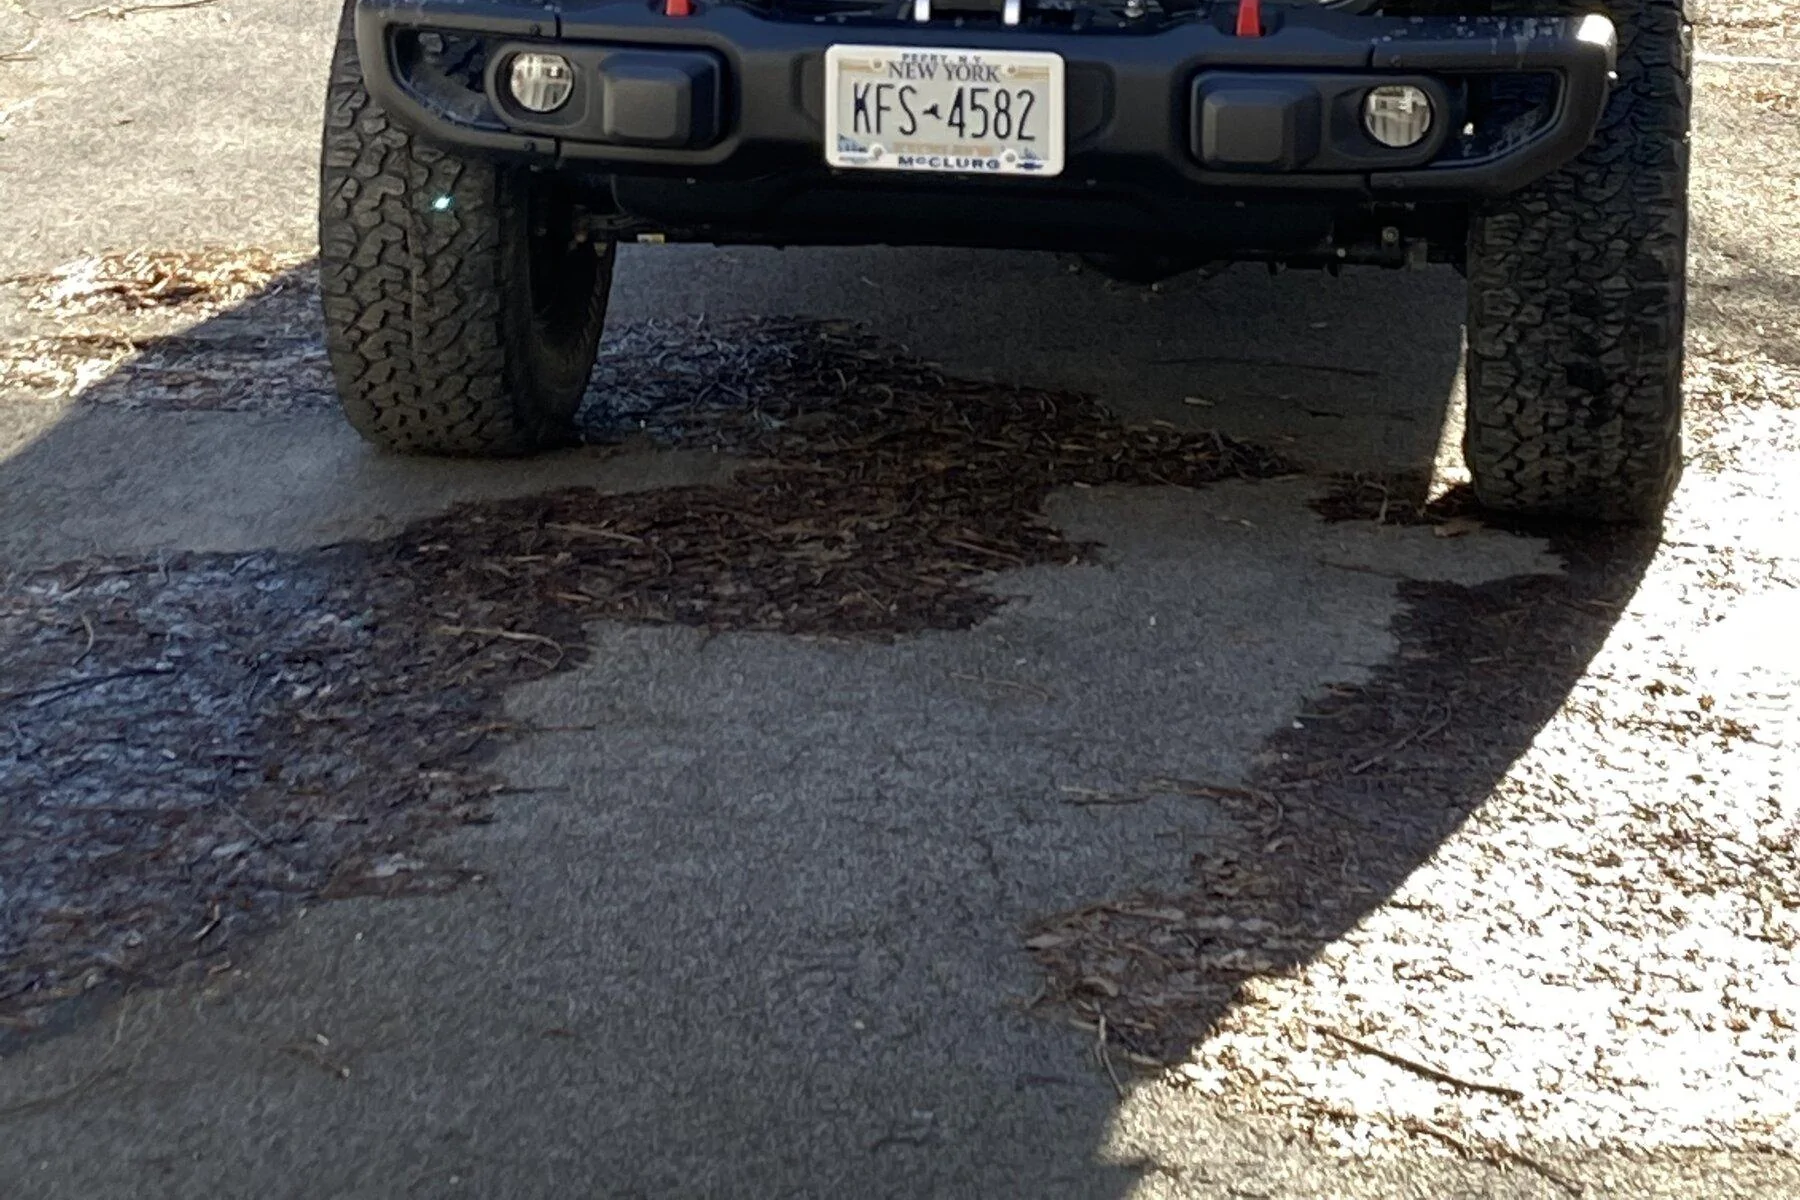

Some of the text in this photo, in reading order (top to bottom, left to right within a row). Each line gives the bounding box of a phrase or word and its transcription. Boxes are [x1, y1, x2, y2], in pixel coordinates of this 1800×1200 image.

[887, 60, 1001, 83] NEW YORK
[853, 83, 1036, 141] KFS 4582
